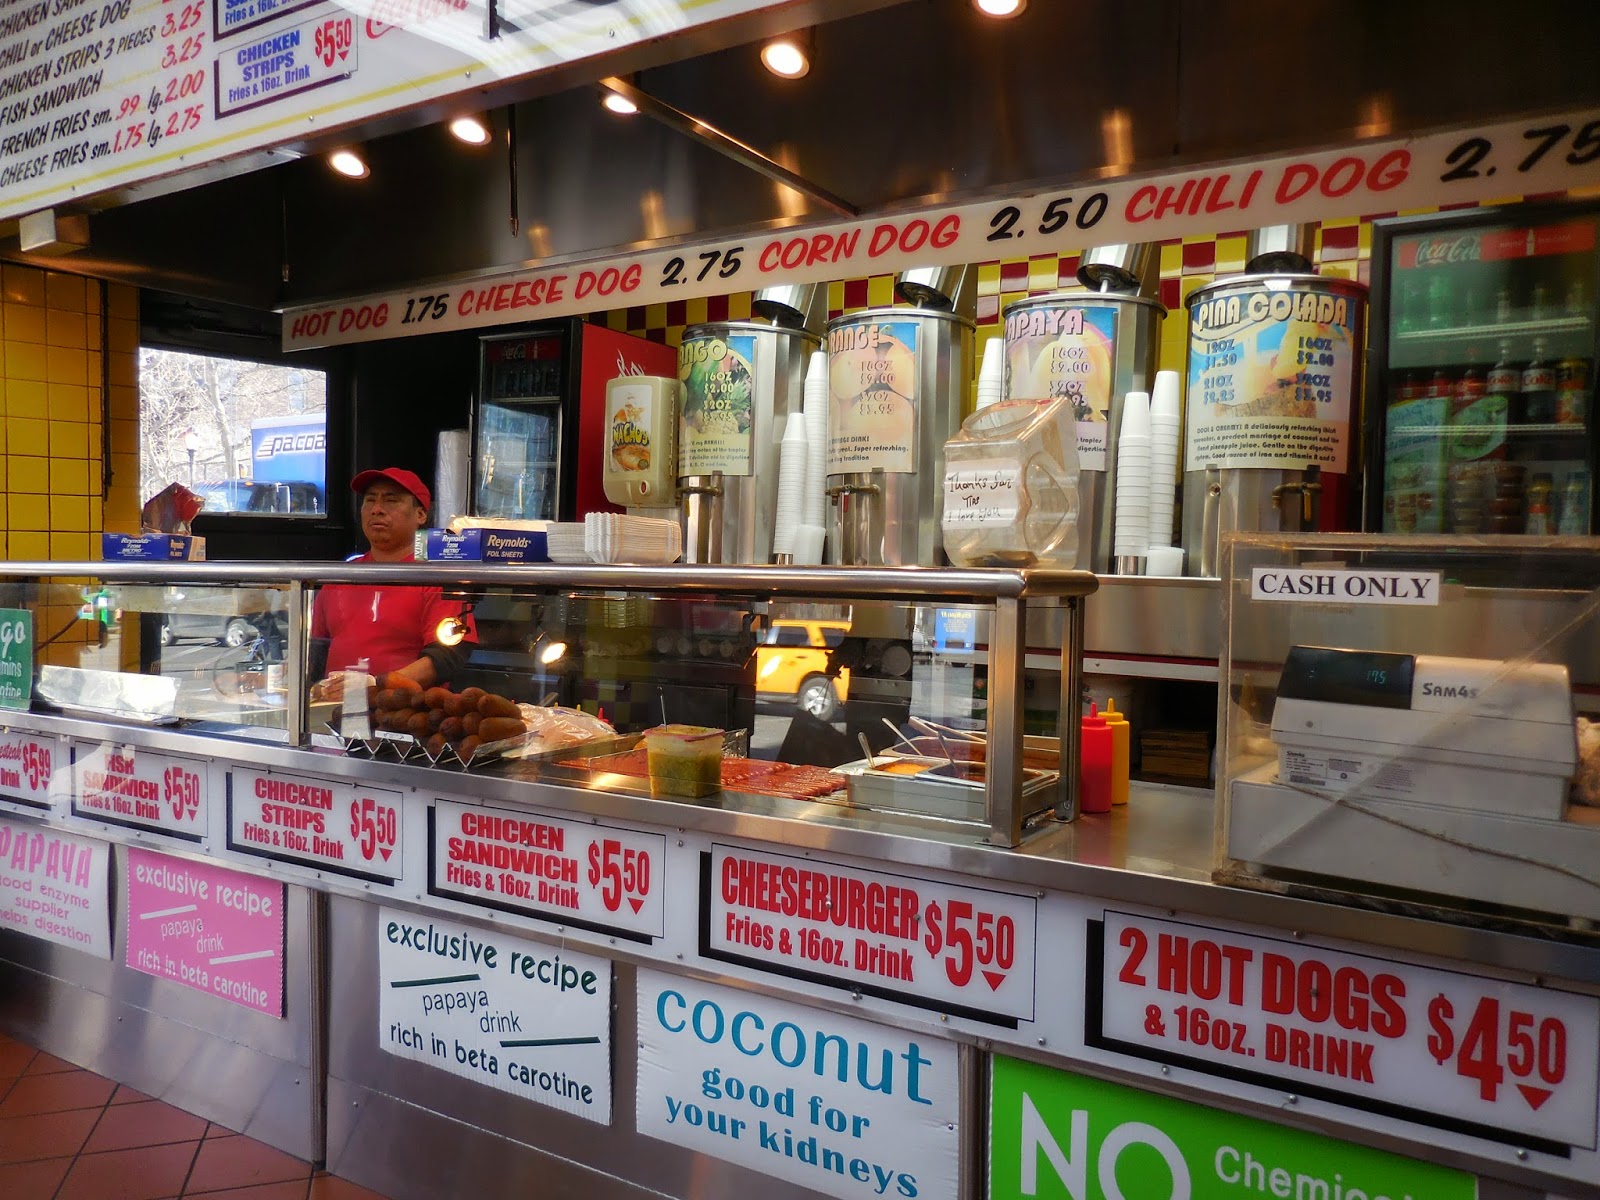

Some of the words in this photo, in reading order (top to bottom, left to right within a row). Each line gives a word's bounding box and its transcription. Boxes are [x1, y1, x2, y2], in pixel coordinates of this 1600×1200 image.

[30, 41, 43, 57] or
[45, 10, 98, 50] CHEESE
[100, 0, 132, 28] DOG
[237, 29, 300, 66] CHICKEN
[0, 61, 52, 98] CHICKEN
[53, 40, 103, 78] STRIPS
[104, 38, 115, 59] 3
[117, 25, 156, 54] PIECES
[160, 1, 205, 37] 3.25
[243, 52, 294, 81] STRIPS
[1, 103, 29, 125] FISH
[31, 69, 103, 116] SANDWICH
[162, 32, 205, 69] 3.25
[228, 84, 250, 103] Fries
[252, 82, 259, 95] &
[261, 75, 283, 93] 16oz.
[285, 64, 310, 85] Drink
[1, 122, 50, 156] FRENCH
[51, 110, 90, 142] FRIES
[91, 108, 113, 128] sm.
[165, 70, 205, 102] 2.00
[1, 154, 48, 187] CHEESE
[50, 141, 91, 172] FRIES
[90, 141, 112, 160] sm.
[113, 123, 145, 153] 1.75
[165, 104, 205, 137] 2.75
[292, 311, 337, 340] HOT
[338, 303, 389, 332] DOG
[401, 294, 451, 324] 1.75
[457, 275, 567, 317] CHEESE
[574, 263, 642, 299] DOG
[659, 247, 744, 288] 2.75
[758, 229, 861, 273] CORN
[868, 214, 961, 257] DOG
[986, 192, 1109, 242] 2.50
[1124, 169, 1264, 224] CHILI
[1274, 149, 1412, 205] DOG
[1005, 309, 1084, 341] APAYA
[1199, 295, 1241, 332] PINA
[1247, 293, 1347, 327] COLADA
[680, 339, 728, 366] NGO
[828, 325, 880, 355] RANGE
[1297, 350, 1335, 367] $2.00
[487, 534, 529, 550] Reynolds
[1258, 573, 1335, 596] CASH
[1344, 576, 1432, 598] ONLY
[0, 767, 21, 789] Drink
[83, 770, 159, 801] SANDWICH
[255, 778, 333, 811] CHICKEN
[104, 796, 111, 811] &
[135, 800, 160, 821] Drink
[261, 803, 325, 834] STRIPS
[243, 822, 270, 845] Fries
[272, 832, 281, 847] &
[283, 830, 310, 853] 16oz.
[313, 838, 344, 860] Drink
[461, 812, 564, 852] CHICKEN
[0, 825, 93, 889] PAPAYA
[448, 837, 578, 884] SANDWICH
[39, 885, 90, 910] enzyme
[136, 864, 209, 900] exclusive
[216, 886, 273, 918] recipe
[447, 862, 482, 889] Fries
[485, 874, 495, 891] &
[499, 873, 534, 900] 16oz.
[538, 881, 579, 910] Drink
[721, 856, 919, 942] CHEESEBURGER
[15, 896, 70, 921] supplier
[35, 917, 92, 945] digestion
[160, 918, 204, 940] papaya
[197, 934, 225, 954] drink
[726, 911, 774, 951] Fries
[778, 930, 792, 955] &
[798, 927, 849, 968] 16oz.
[854, 938, 914, 982] Drink
[387, 921, 498, 969] exclusive
[510, 951, 597, 995] recipe
[138, 949, 161, 972] rich
[165, 955, 176, 976] in
[180, 960, 209, 988] beta
[214, 975, 268, 1008] carotine
[1119, 927, 1148, 986] 2
[1158, 932, 1253, 1006] HOT
[1262, 951, 1407, 1038] DOGS
[422, 990, 489, 1016] papaya
[479, 1011, 522, 1034] drink
[390, 1022, 423, 1051] rich
[431, 1032, 447, 1059] in
[455, 1039, 498, 1075] beta
[508, 1061, 593, 1105] carotine
[656, 989, 933, 1106] coconut
[1144, 1004, 1165, 1037] &
[1265, 1023, 1374, 1084] DRINK
[701, 1067, 794, 1118] good
[807, 1095, 870, 1138] for
[665, 1095, 746, 1139] your
[759, 1121, 918, 1198] kidneys
[1020, 1091, 1192, 1200] NO
[1214, 1145, 1413, 1200] Chemi
